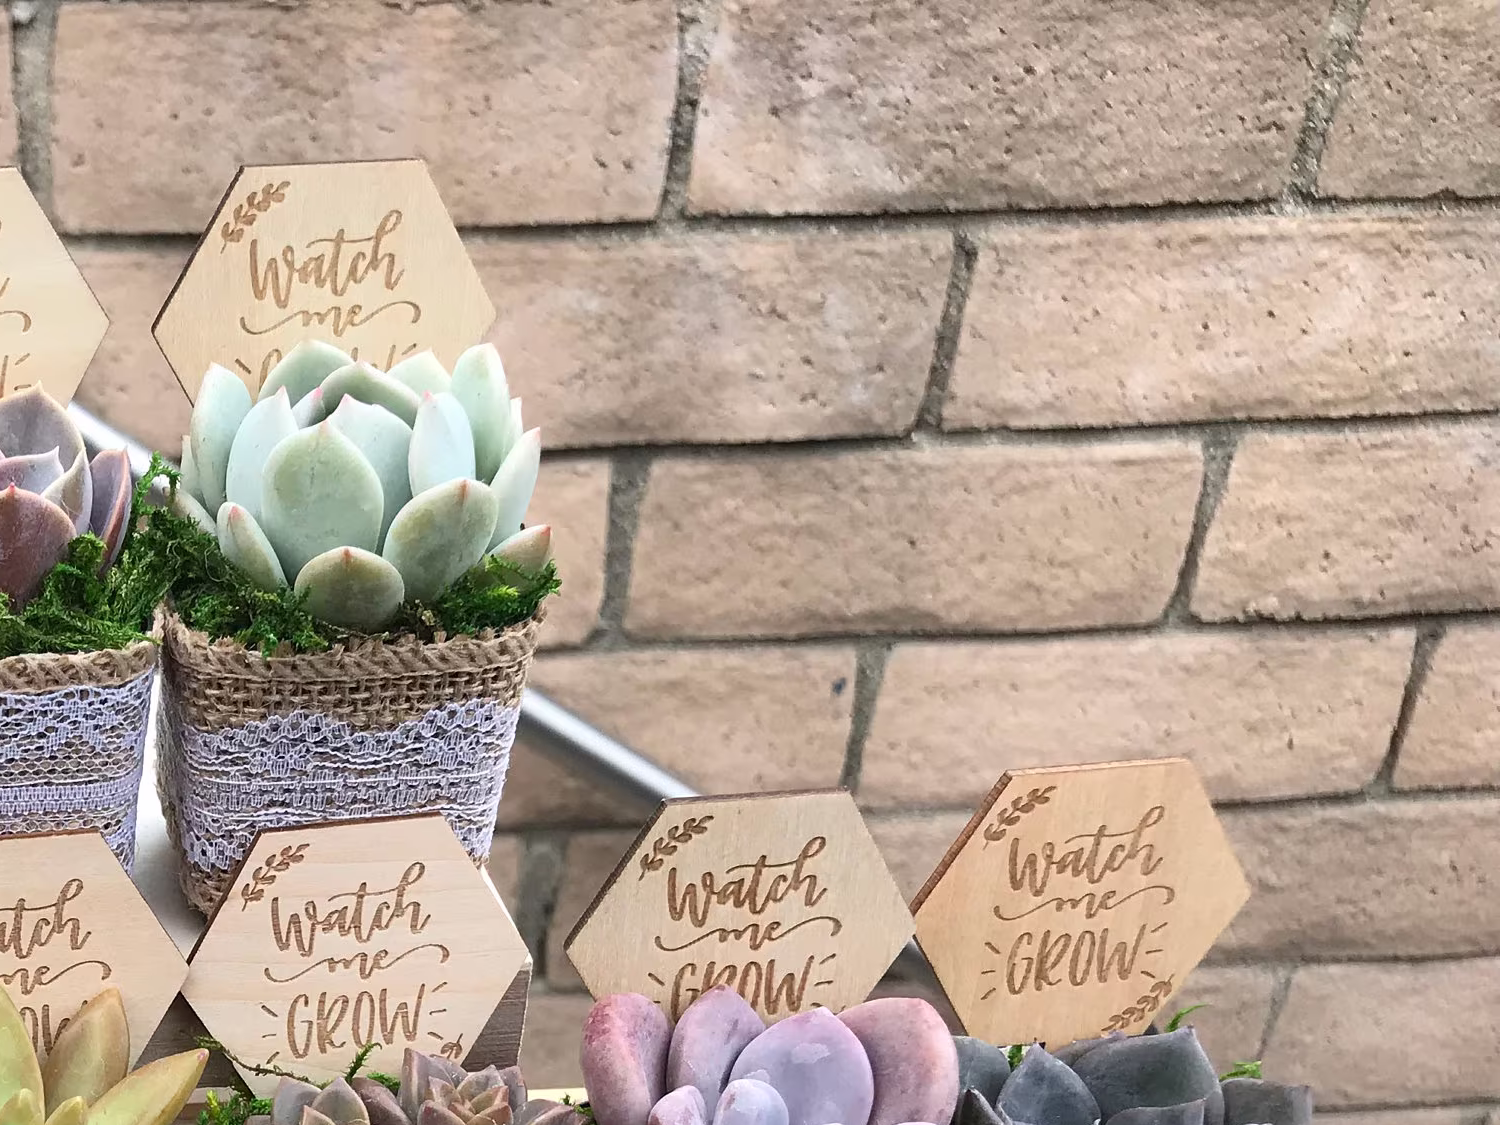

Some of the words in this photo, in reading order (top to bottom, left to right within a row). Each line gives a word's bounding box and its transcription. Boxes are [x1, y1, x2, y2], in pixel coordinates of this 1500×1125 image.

[250, 209, 405, 309] Watch
[668, 836, 828, 928] Watch
[1008, 805, 1165, 897] Watch
[271, 861, 431, 958] Watch
[1006, 923, 1147, 996] GROW
[287, 983, 426, 1060] GROW
